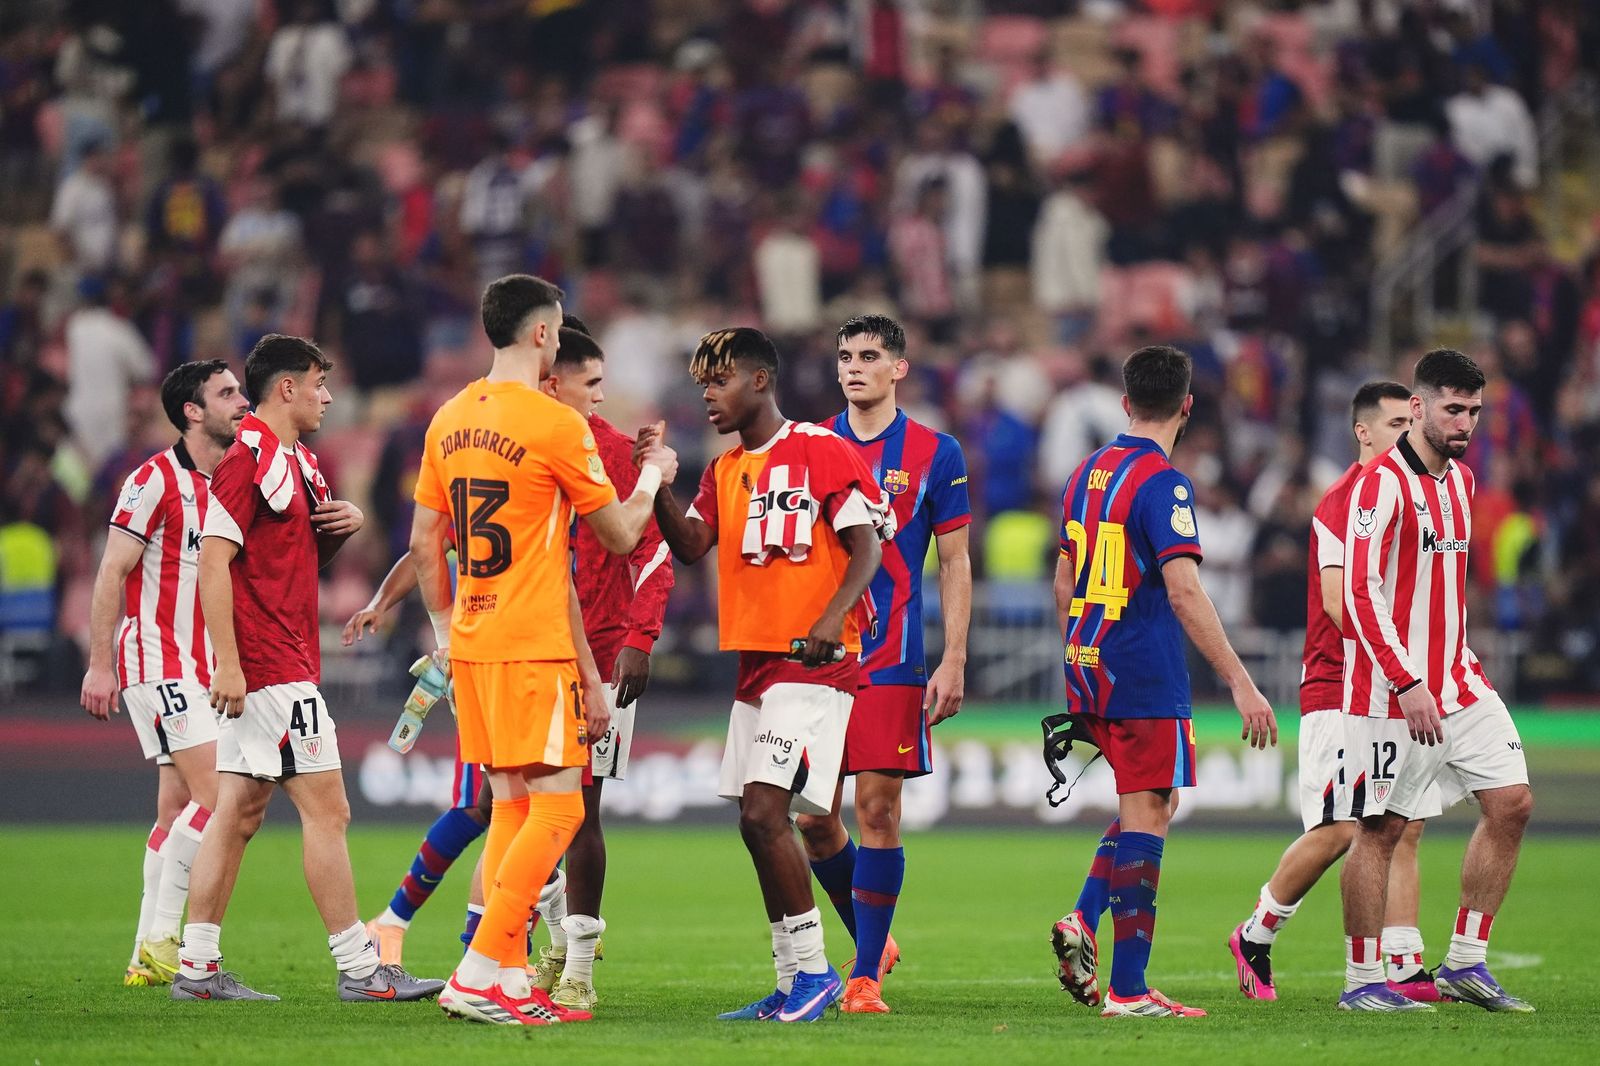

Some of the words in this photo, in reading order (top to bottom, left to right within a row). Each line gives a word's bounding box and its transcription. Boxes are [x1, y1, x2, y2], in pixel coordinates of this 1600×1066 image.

[441, 429, 470, 459] JOAN
[473, 429, 528, 467] GARCIA
[1088, 468, 1113, 491] ERIC
[449, 477, 512, 578] 13
[1066, 520, 1129, 621] 24
[156, 682, 187, 716] 15
[290, 697, 317, 737] 47
[755, 730, 793, 754] ueling
[1371, 741, 1396, 779] 12
